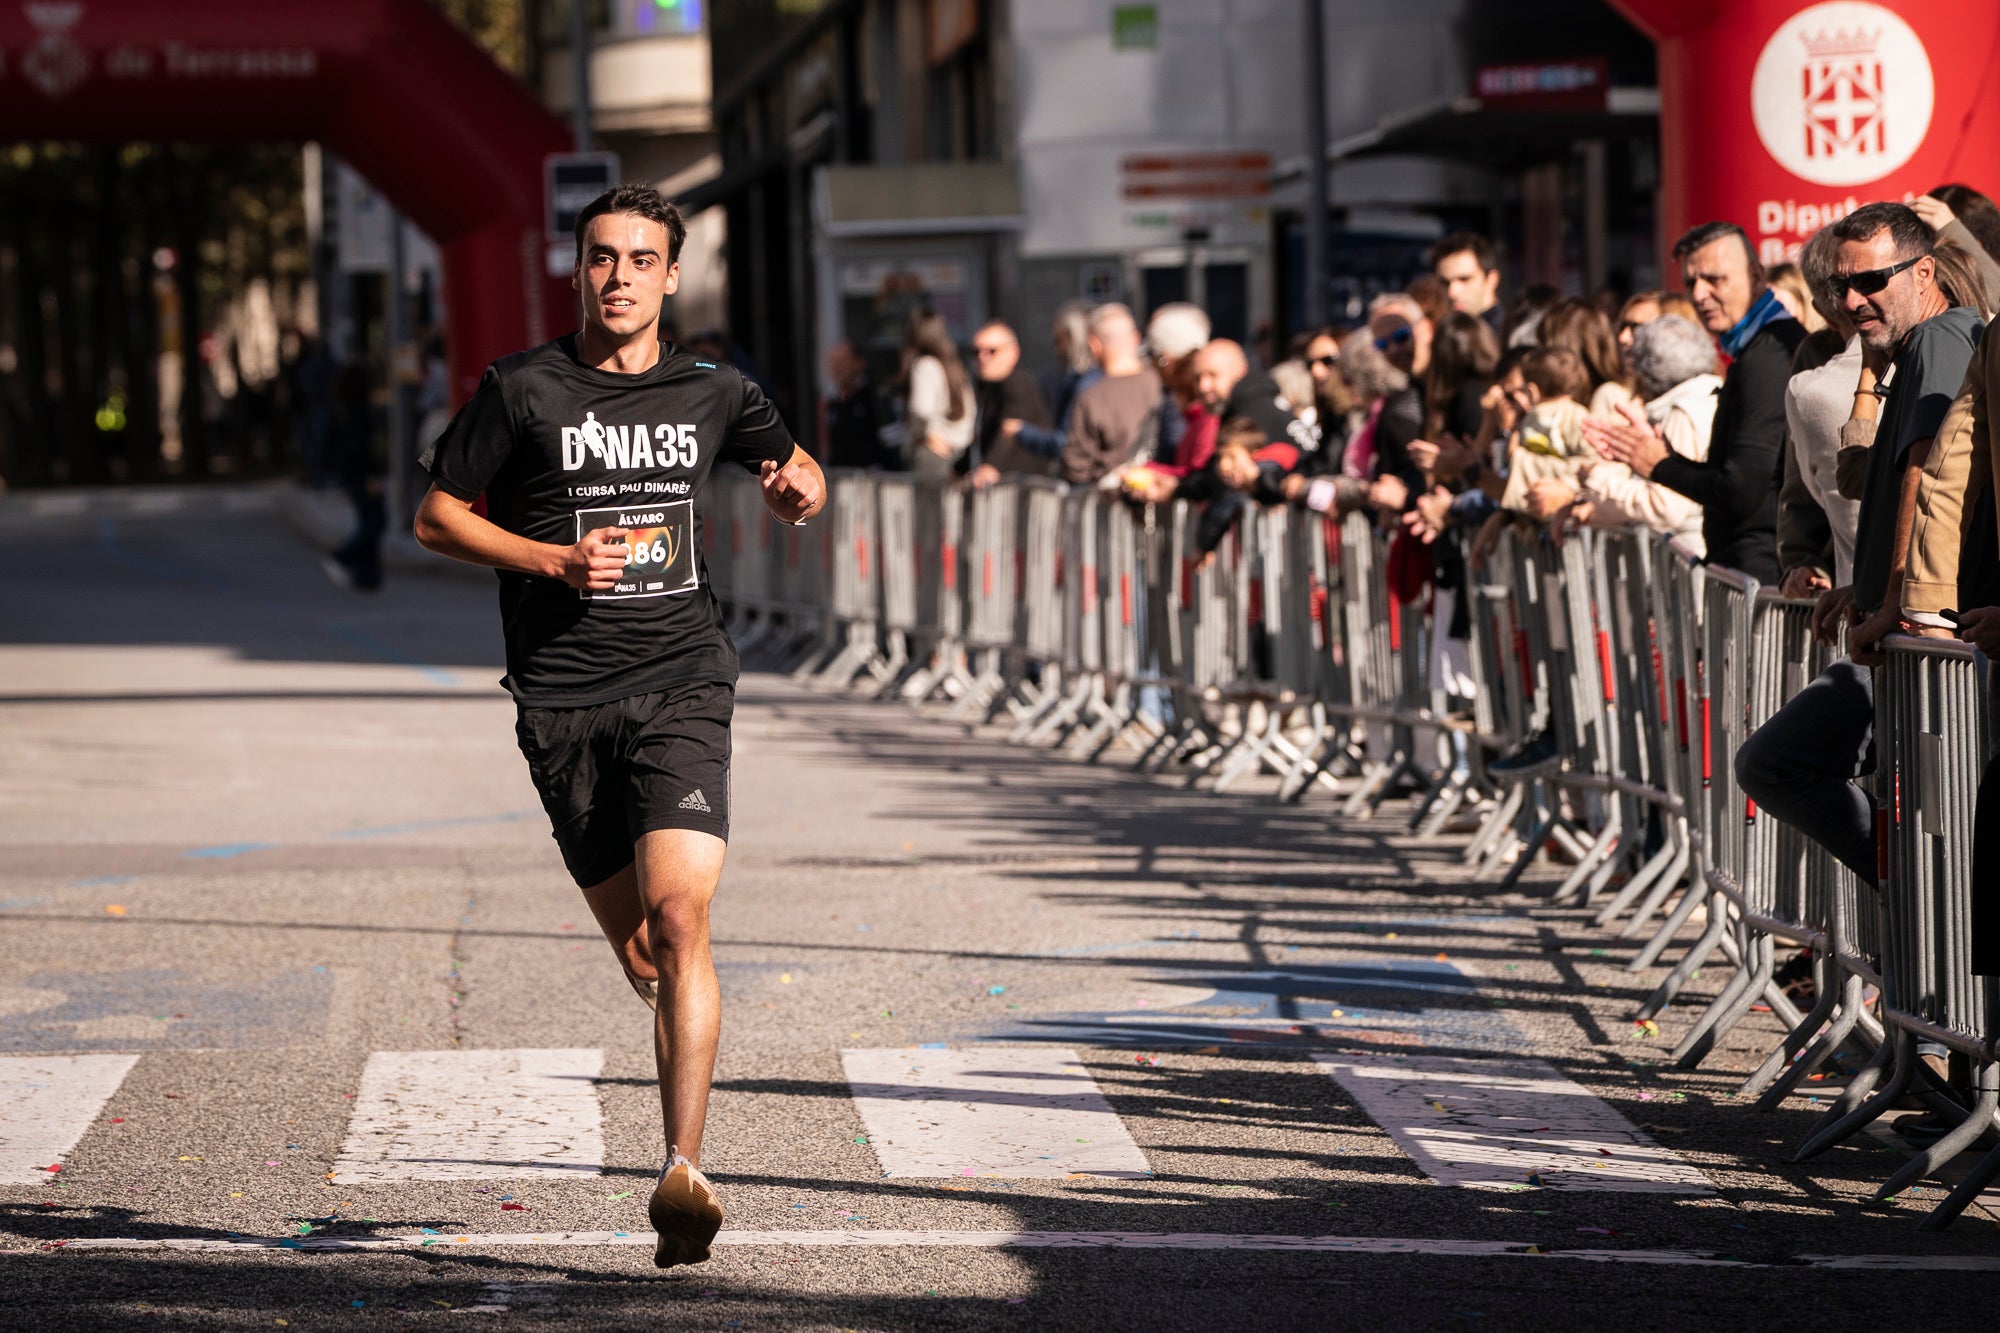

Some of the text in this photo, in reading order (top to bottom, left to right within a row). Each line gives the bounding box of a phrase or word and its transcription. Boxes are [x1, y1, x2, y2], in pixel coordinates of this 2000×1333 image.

[575, 485, 616, 497] CURSA
[619, 482, 642, 494] PAU
[644, 481, 691, 495] DINARÈS
[678, 801, 711, 813] adidas
